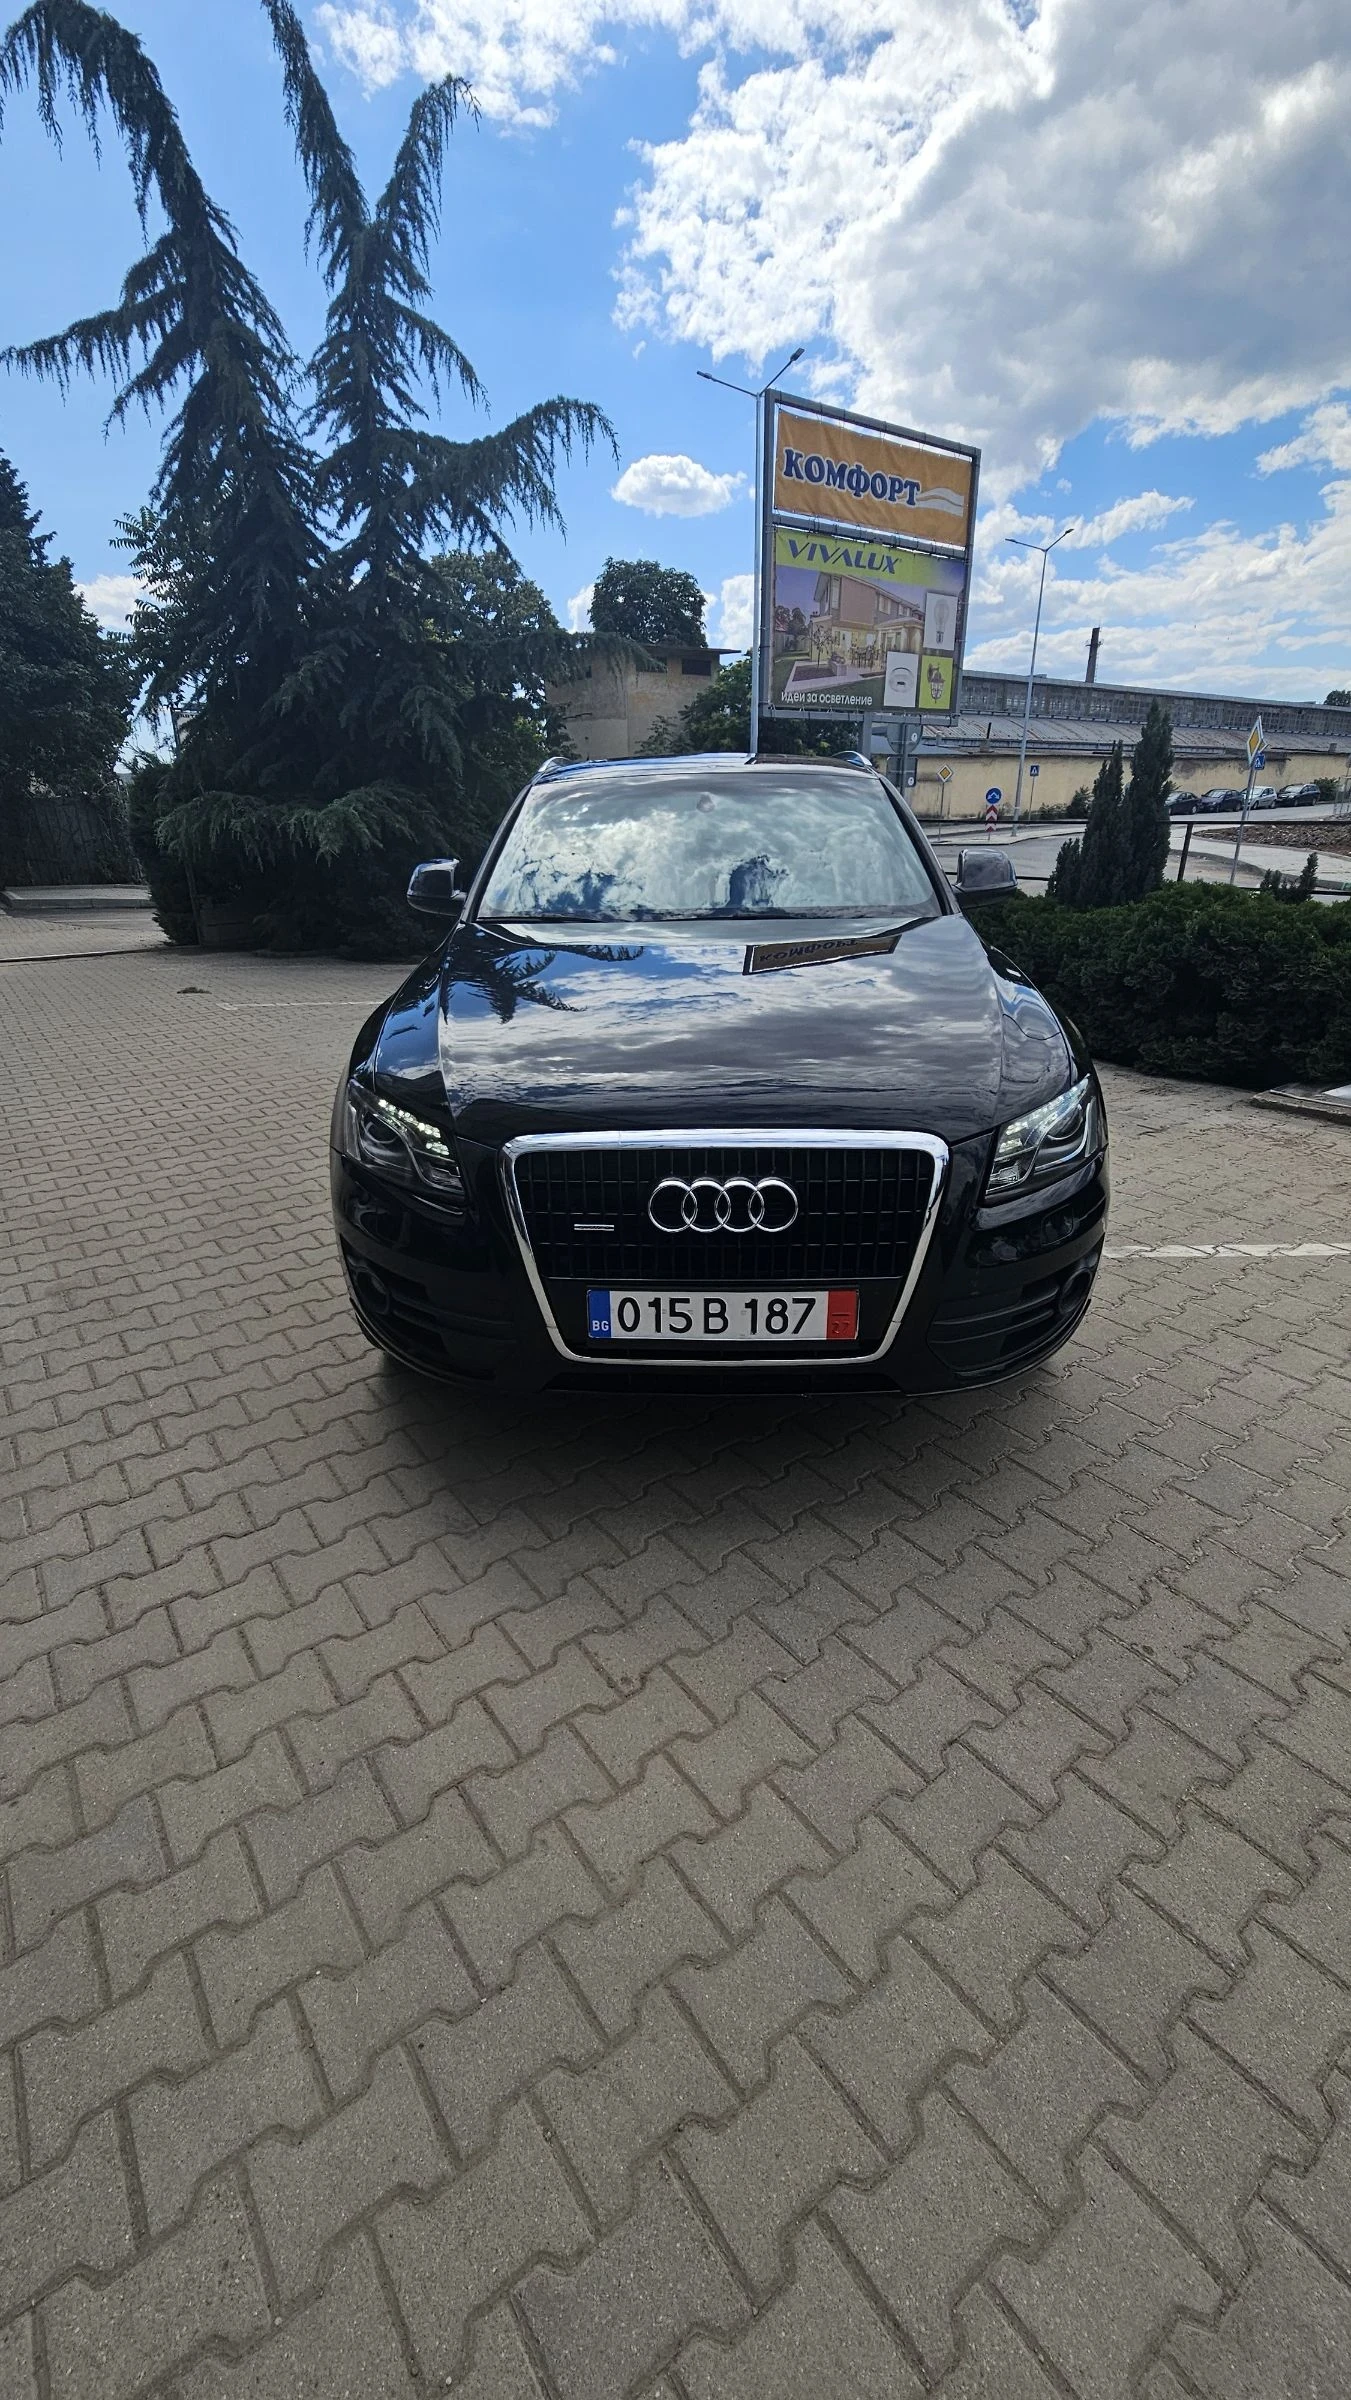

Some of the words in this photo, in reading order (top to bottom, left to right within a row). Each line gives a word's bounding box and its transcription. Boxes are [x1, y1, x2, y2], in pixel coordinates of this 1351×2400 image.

[783, 448, 921, 506] КОМФОРТ
[788, 538, 899, 575] VIVALUX
[806, 692, 817, 703] за
[819, 693, 873, 706] осветление
[592, 1320, 609, 1332] BG
